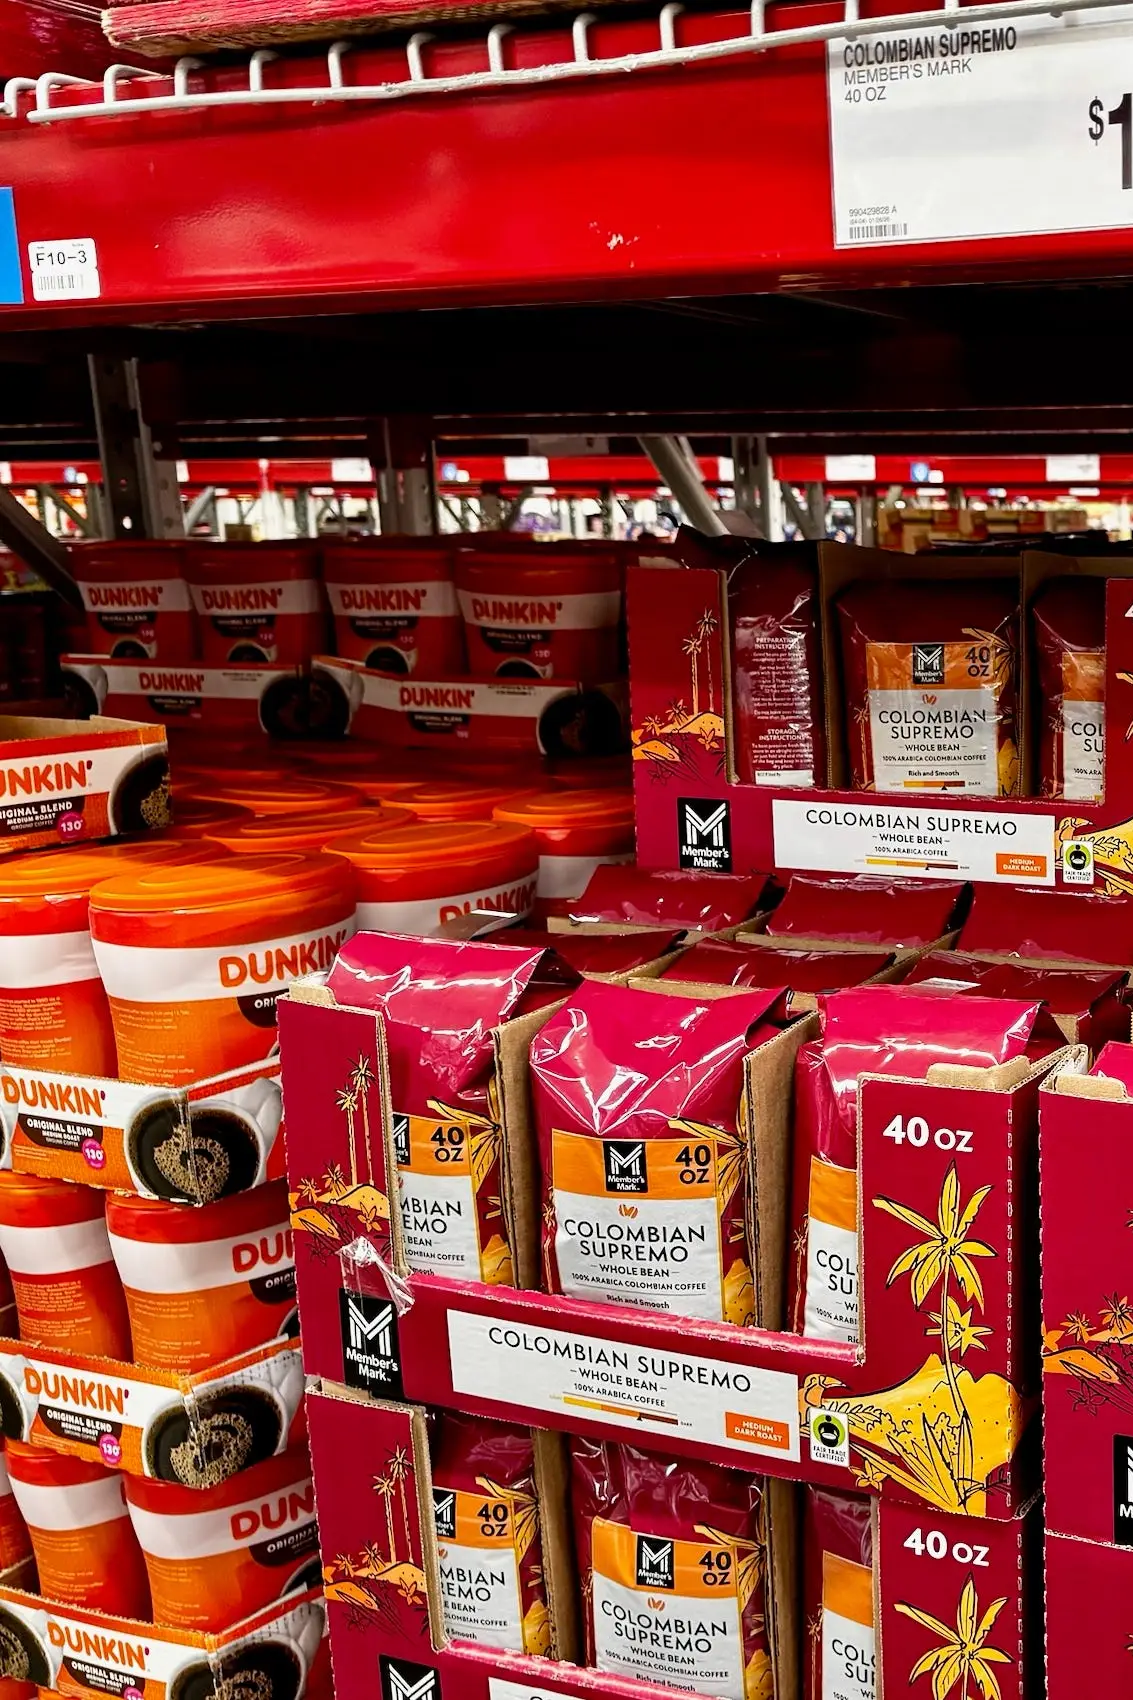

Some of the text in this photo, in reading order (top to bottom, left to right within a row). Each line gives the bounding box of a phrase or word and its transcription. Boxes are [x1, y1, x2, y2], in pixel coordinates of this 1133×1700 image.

[843, 26, 1017, 68] COLOMBIAN SUPREMO
[844, 58, 972, 86] MEMBER'S MARK
[844, 86, 887, 103] 40 OZ
[35, 250, 88, 266] F10-3
[87, 586, 163, 606] DUNKIN'
[201, 588, 283, 610] DUNKIN'
[340, 589, 427, 611] DUNKIN'
[472, 598, 563, 625] DUNKIN'
[964, 646, 991, 664] 40
[138, 672, 204, 692] DUNKIN'
[399, 686, 475, 709] DUNKIN'
[878, 709, 987, 725] COLOMBIAN
[890, 725, 974, 740] SUPREMO
[904, 743, 960, 752] WHOLE BEAN
[908, 769, 960, 777] Rich and Smooth
[40, 801, 73, 812] BLEND
[7, 812, 56, 826] MEDIUM ROAST
[805, 809, 1018, 836] COLOMBIAN SUPREMO
[879, 833, 943, 845] WHOLE BEAN
[681, 845, 730, 859] Member's
[693, 857, 719, 868] Mark
[219, 929, 348, 988] DUNKIN'
[1, 1074, 106, 1118] DUNKIN'
[26, 1118, 93, 1138] ORIGINAL BLEND
[430, 1126, 465, 1146] 40
[883, 1114, 930, 1147] 40
[434, 1147, 464, 1162] OZ
[675, 1144, 712, 1168] 40
[679, 1169, 710, 1185] OZ
[564, 1218, 705, 1243] COLOMBIAN
[407, 1236, 432, 1247] BEAN
[580, 1240, 689, 1263] SUPREMO
[599, 1264, 670, 1278] WHOLE BEAN
[345, 1347, 399, 1372] Member's
[488, 1327, 751, 1392] COLOMBIAN SUPREMO
[358, 1363, 386, 1381] Mark
[578, 1367, 658, 1392] WHOLE BEAN
[24, 1366, 130, 1416] DUNKIN'
[46, 1408, 112, 1433] ORIGINAL BLEND
[742, 1420, 774, 1432] MEDIUM
[477, 1503, 509, 1523] 40
[480, 1524, 508, 1537] OZ
[903, 1527, 948, 1559] 40
[699, 1551, 732, 1571] 40
[703, 1572, 731, 1586] OZ
[451, 1602, 476, 1613] BEAN
[601, 1600, 727, 1636] COLOMBIAN
[47, 1621, 150, 1671] DUNKIN'
[614, 1622, 712, 1653] SUPREMO
[630, 1646, 695, 1665] WHOLE BEAN
[71, 1661, 136, 1687] ORIGINAL BLEND
